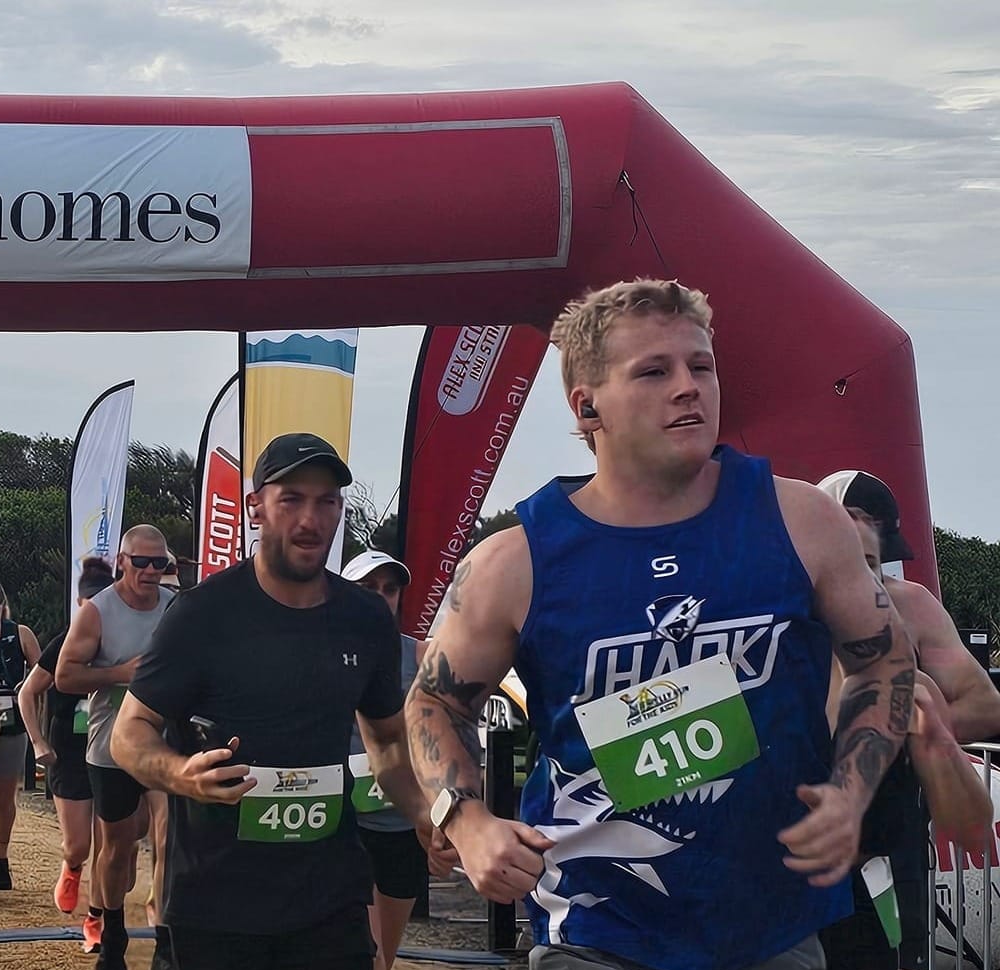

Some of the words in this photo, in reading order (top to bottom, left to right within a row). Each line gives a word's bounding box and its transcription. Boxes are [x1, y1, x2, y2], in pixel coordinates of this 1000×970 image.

[442, 354, 470, 399] ALEX
[208, 493, 236, 569] SCOTT
[414, 376, 529, 635] www.alexscott.com.au
[634, 719, 723, 778] 410
[258, 802, 327, 830] 406
